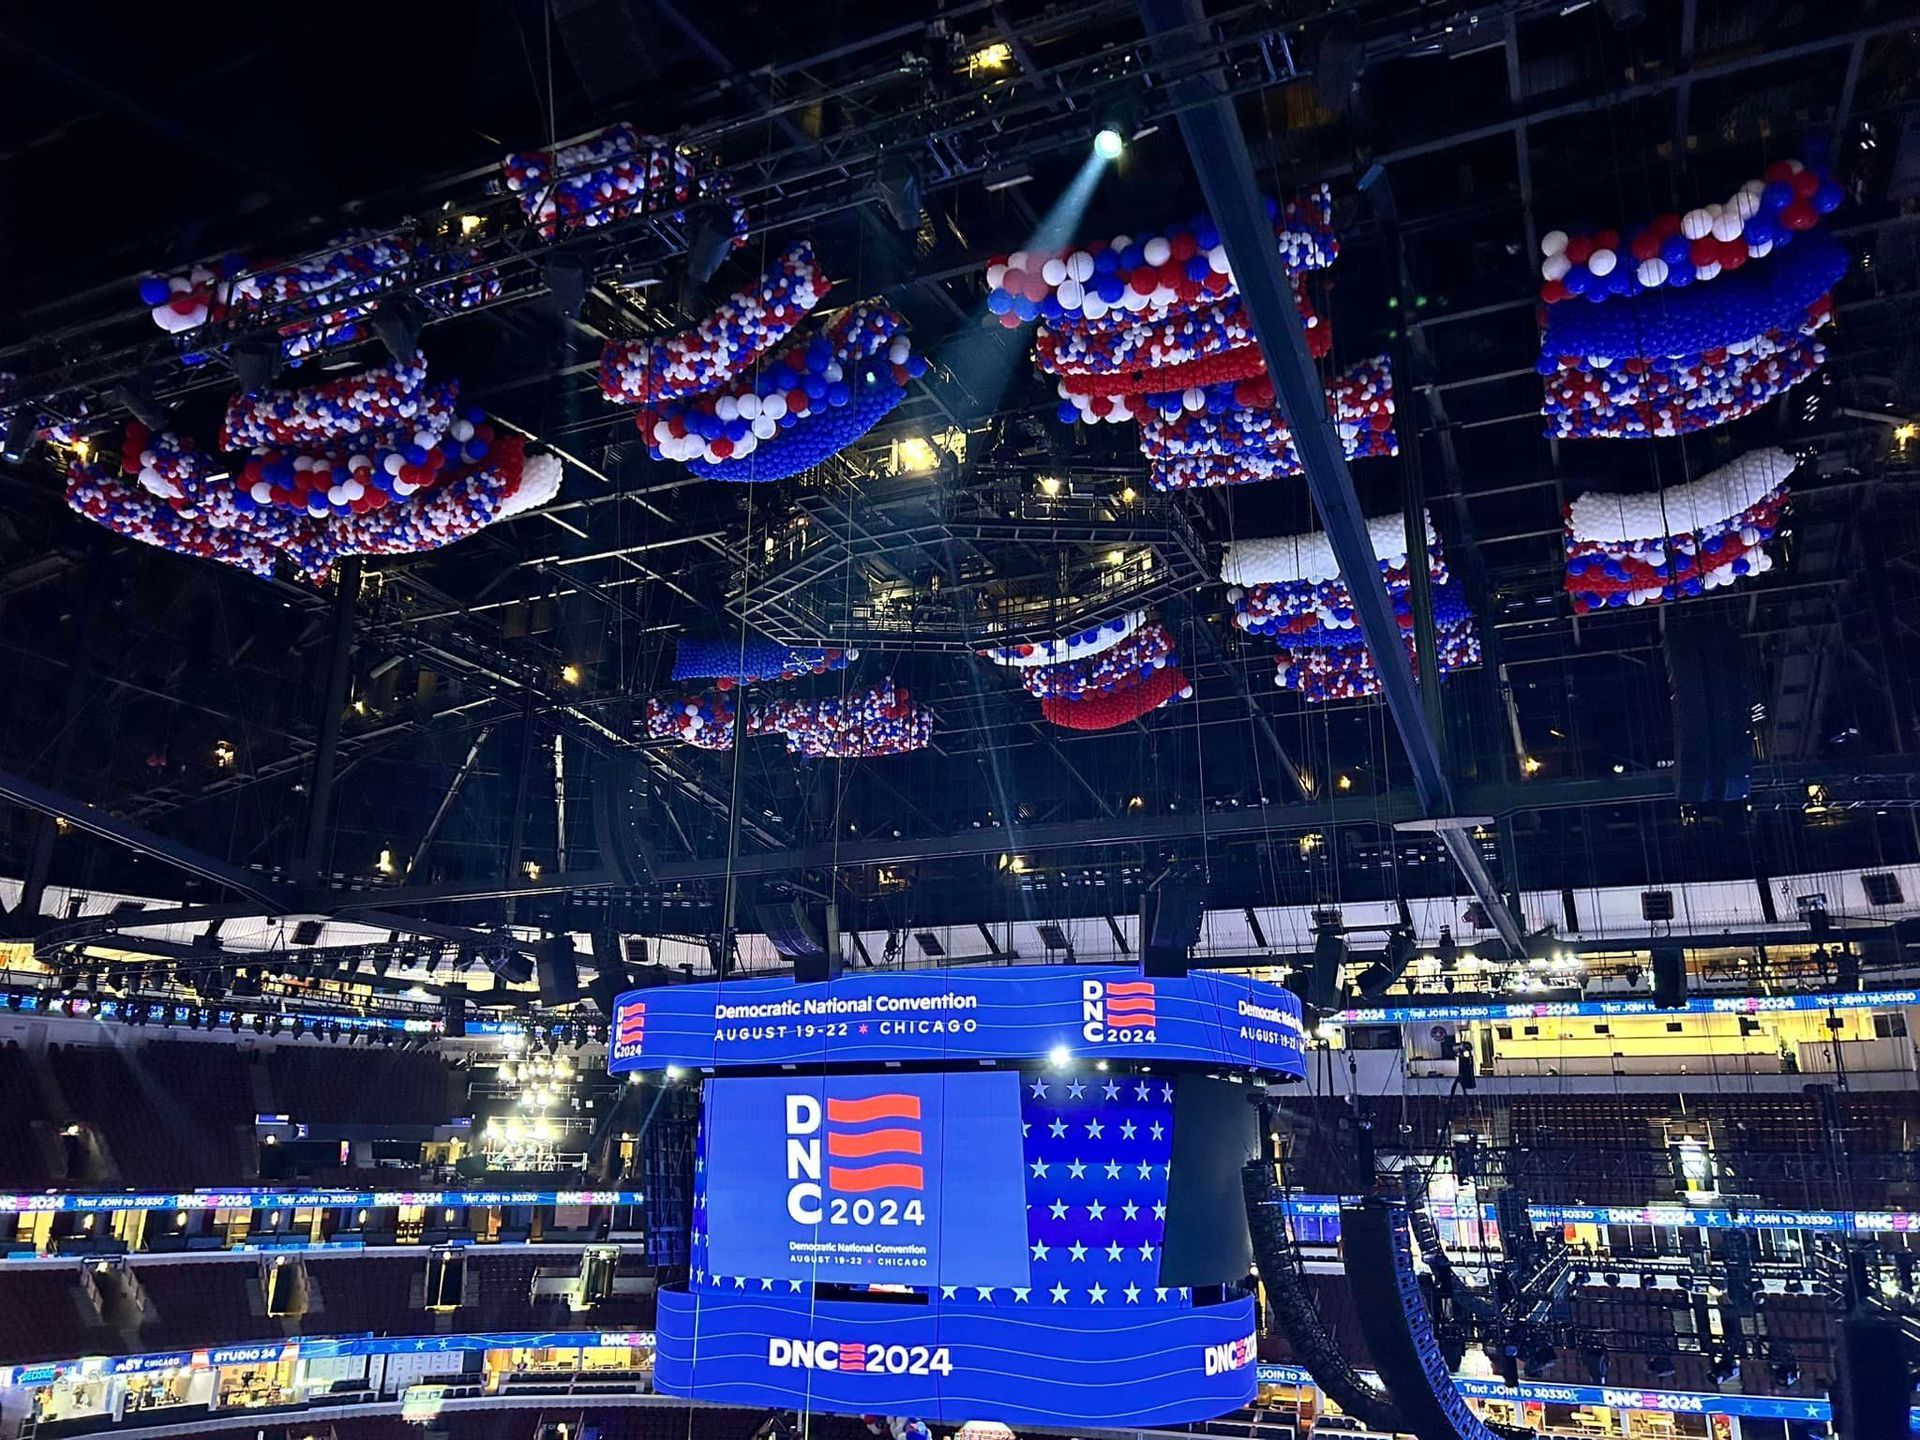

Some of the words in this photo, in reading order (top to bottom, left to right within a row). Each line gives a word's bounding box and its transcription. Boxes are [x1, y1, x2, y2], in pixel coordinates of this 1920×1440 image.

[715, 1000, 800, 1020] Democratic
[804, 996, 872, 1014] National
[876, 993, 977, 1012] Convention
[1083, 979, 1104, 1042] DNC
[1107, 1029, 1156, 1043] 2024
[1547, 1003, 1580, 1015] 2024
[1714, 999, 1746, 1011] DNC
[1759, 997, 1795, 1009] 2024
[714, 1026, 787, 1042] AUGUST
[796, 1024, 848, 1037] 19-22
[880, 1019, 977, 1035] CHICAGO
[1240, 1026, 1278, 1045] AUGUST
[620, 1045, 642, 1057] 2024
[786, 1095, 823, 1225] DNC
[830, 1198, 926, 1226] 2024
[28, 1196, 64, 1209] 2024
[98, 1198, 121, 1207] JOIN
[219, 1195, 251, 1207] 2024
[1609, 1209, 1642, 1222] DNC
[1656, 1209, 1695, 1223] 2024
[1754, 1215, 1779, 1224] JOIN
[1796, 1216, 1831, 1225] 30330
[790, 1241, 836, 1253] Democratic
[837, 1242, 874, 1253] National
[874, 1244, 926, 1256] Convention
[790, 1254, 829, 1264] AUGUST
[877, 1257, 927, 1267] CHICAGO
[144, 1358, 180, 1367] CHICAGO
[214, 1351, 259, 1362] STUDIO
[260, 1349, 277, 1358] 24
[768, 1338, 839, 1370] DNC
[866, 1344, 953, 1376] 2024
[1204, 1341, 1237, 1376] DNC
[1260, 1371, 1284, 1379] JOIN
[1286, 1372, 1297, 1380] to
[1463, 1383, 1488, 1393] Text
[1490, 1385, 1518, 1395] JOIN
[1520, 1386, 1531, 1396] to
[1534, 1388, 1571, 1399] 30330
[1602, 1390, 1642, 1406] DNC
[1656, 1394, 1702, 1410] 2024
